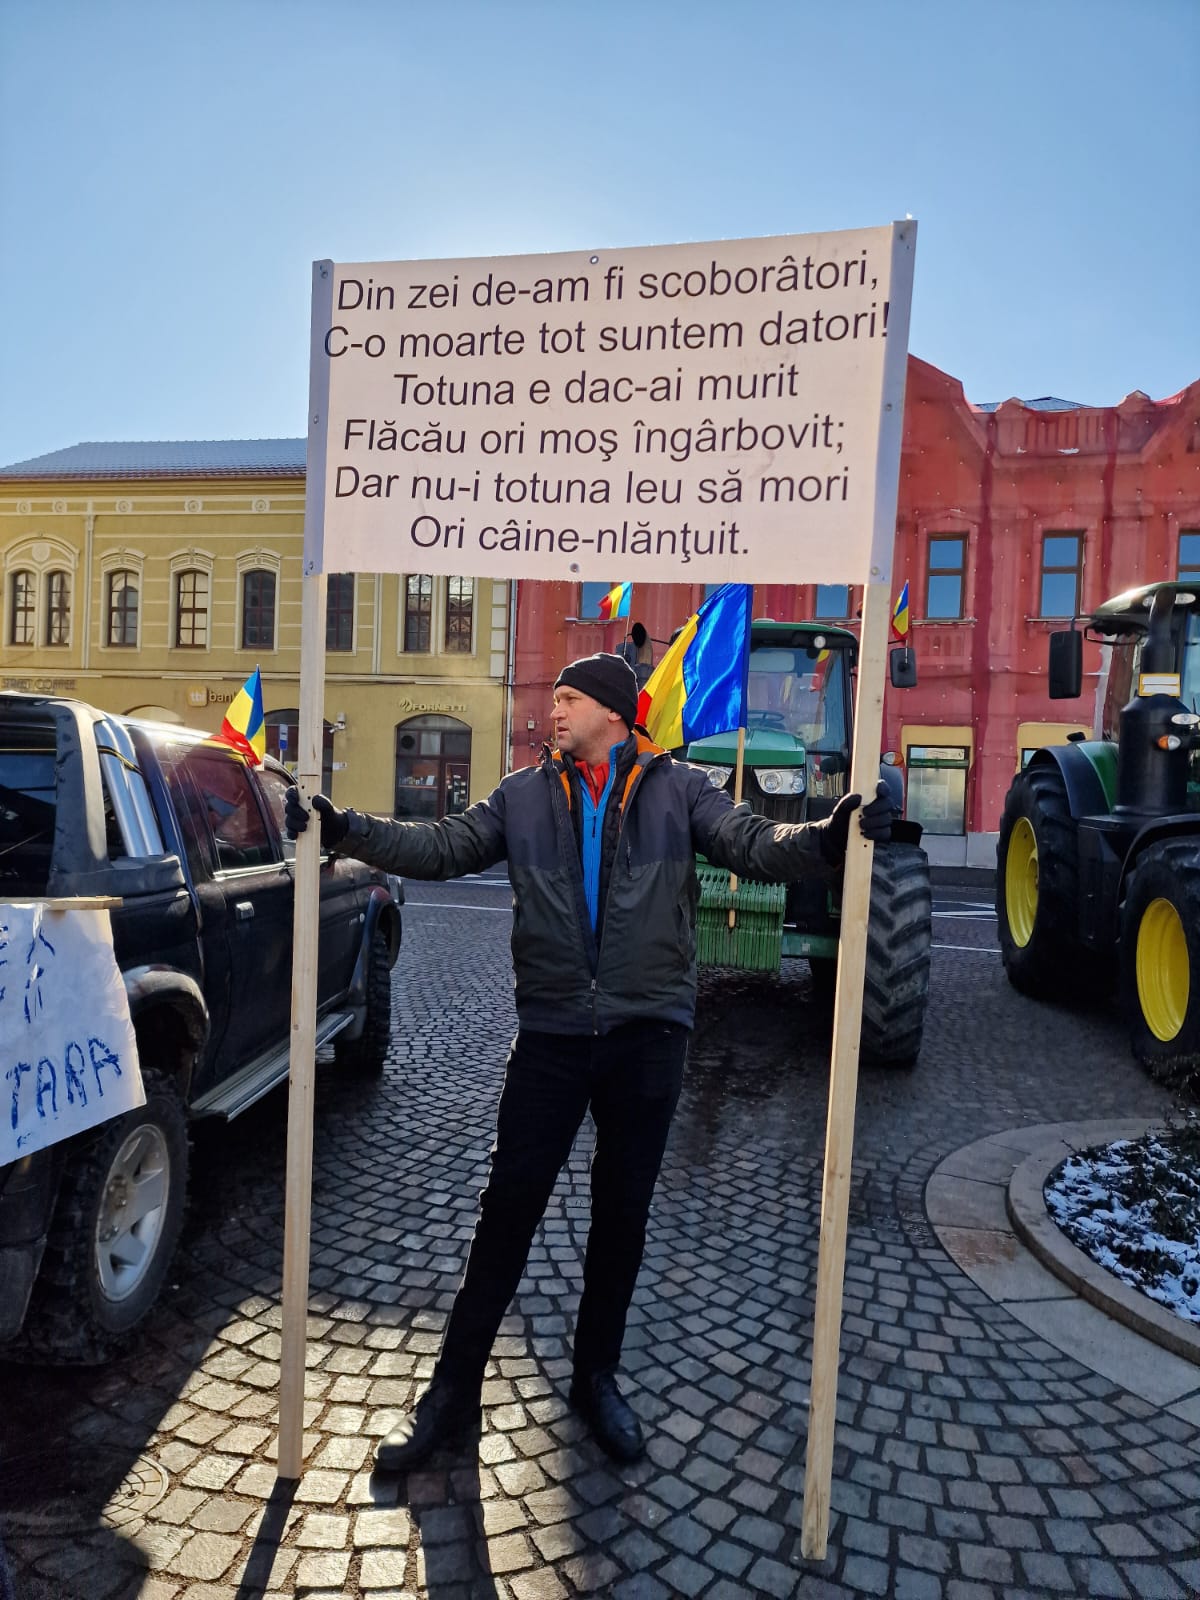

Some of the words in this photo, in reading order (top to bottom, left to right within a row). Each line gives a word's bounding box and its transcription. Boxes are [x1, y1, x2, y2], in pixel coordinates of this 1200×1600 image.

[338, 279, 394, 311] Din
[407, 279, 460, 310] zei
[471, 272, 589, 307] de-am
[603, 265, 624, 301] fi
[638, 249, 879, 300] scoborâtori,
[324, 327, 387, 359] C-o
[399, 323, 525, 358] moarte
[538, 320, 587, 354] tot
[598, 314, 744, 353] suntem
[759, 301, 890, 346] datori!
[393, 373, 515, 406] Totuna
[529, 379, 551, 404] e
[564, 367, 683, 404] dac-ai
[697, 362, 800, 401] murit
[343, 418, 467, 453] Flăcău
[480, 421, 525, 455] ori
[632, 412, 845, 463] îngârbovit;
[335, 465, 400, 499] Dar
[411, 474, 481, 504] nu-i
[493, 471, 611, 505] totuna
[626, 470, 682, 505] leu
[697, 468, 743, 504] să
[759, 465, 849, 503] mori
[410, 515, 466, 549] Ori
[412, 703, 468, 713] FORNETTI
